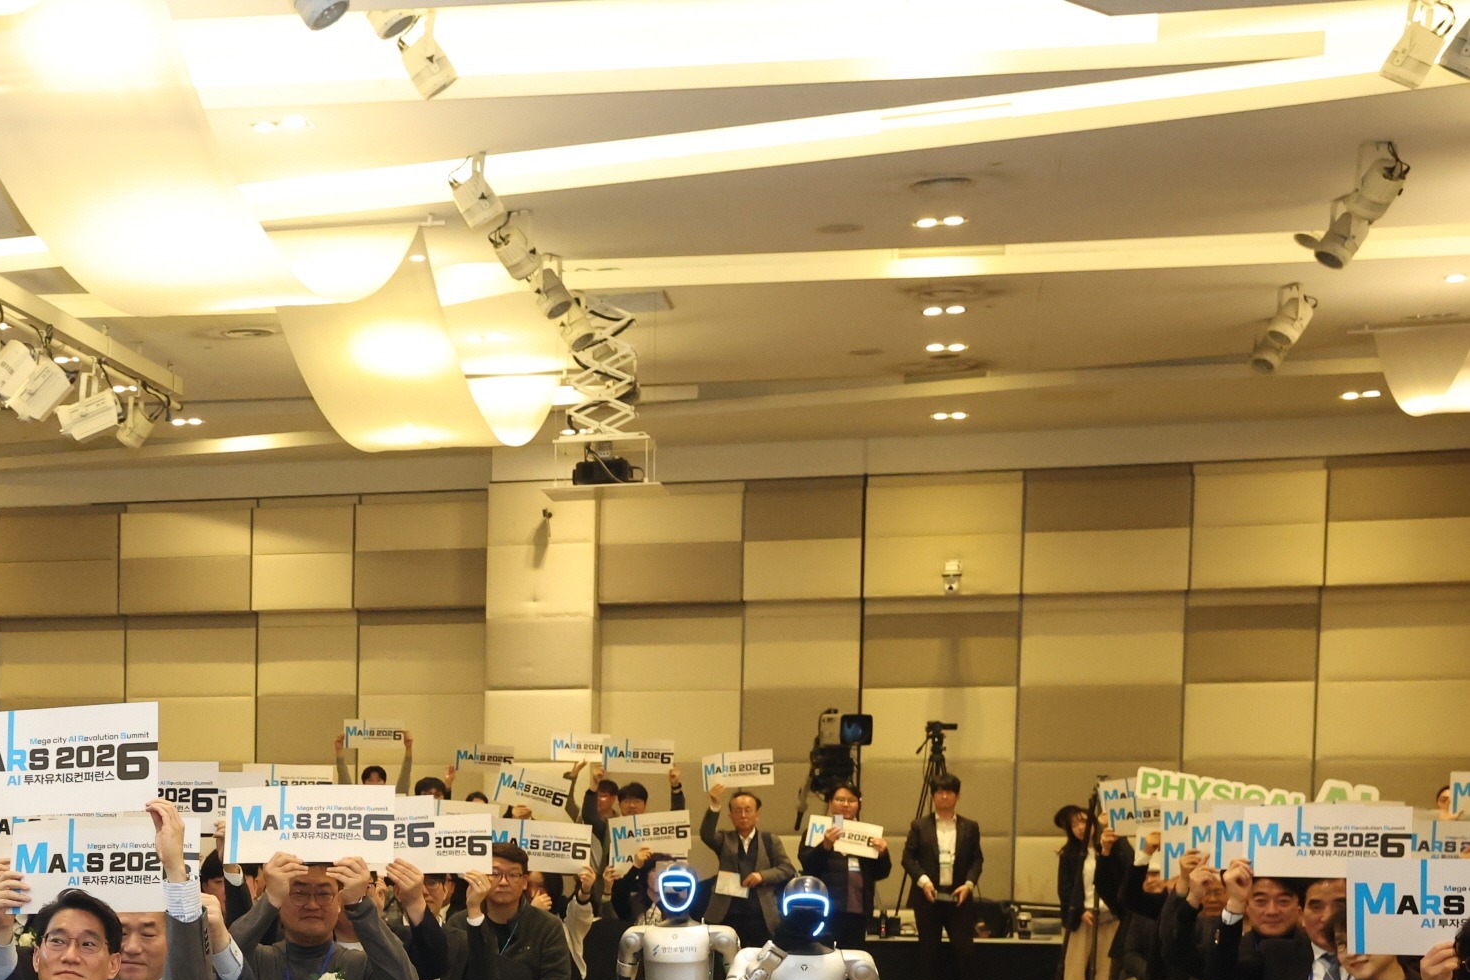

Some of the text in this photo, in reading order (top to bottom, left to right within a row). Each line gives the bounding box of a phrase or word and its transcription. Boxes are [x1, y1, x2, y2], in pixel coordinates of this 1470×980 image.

[30, 731, 150, 746] Mega city AI Revolution Summit
[56, 742, 158, 781] 2026
[7, 775, 21, 786] AI
[532, 786, 568, 807] 2026
[231, 805, 394, 841] MARS 2026
[280, 832, 290, 840] AI
[1249, 823, 1329, 847] MARS
[1334, 832, 1413, 858] 2026
[87, 842, 105, 850] Mega
[106, 842, 119, 850] city
[543, 840, 591, 860] 2026
[16, 842, 104, 874] MARS
[67, 875, 80, 886] AI
[1444, 885, 1467, 893] Mega
[1355, 882, 1465, 915] MARS
[1421, 918, 1435, 928] AI
